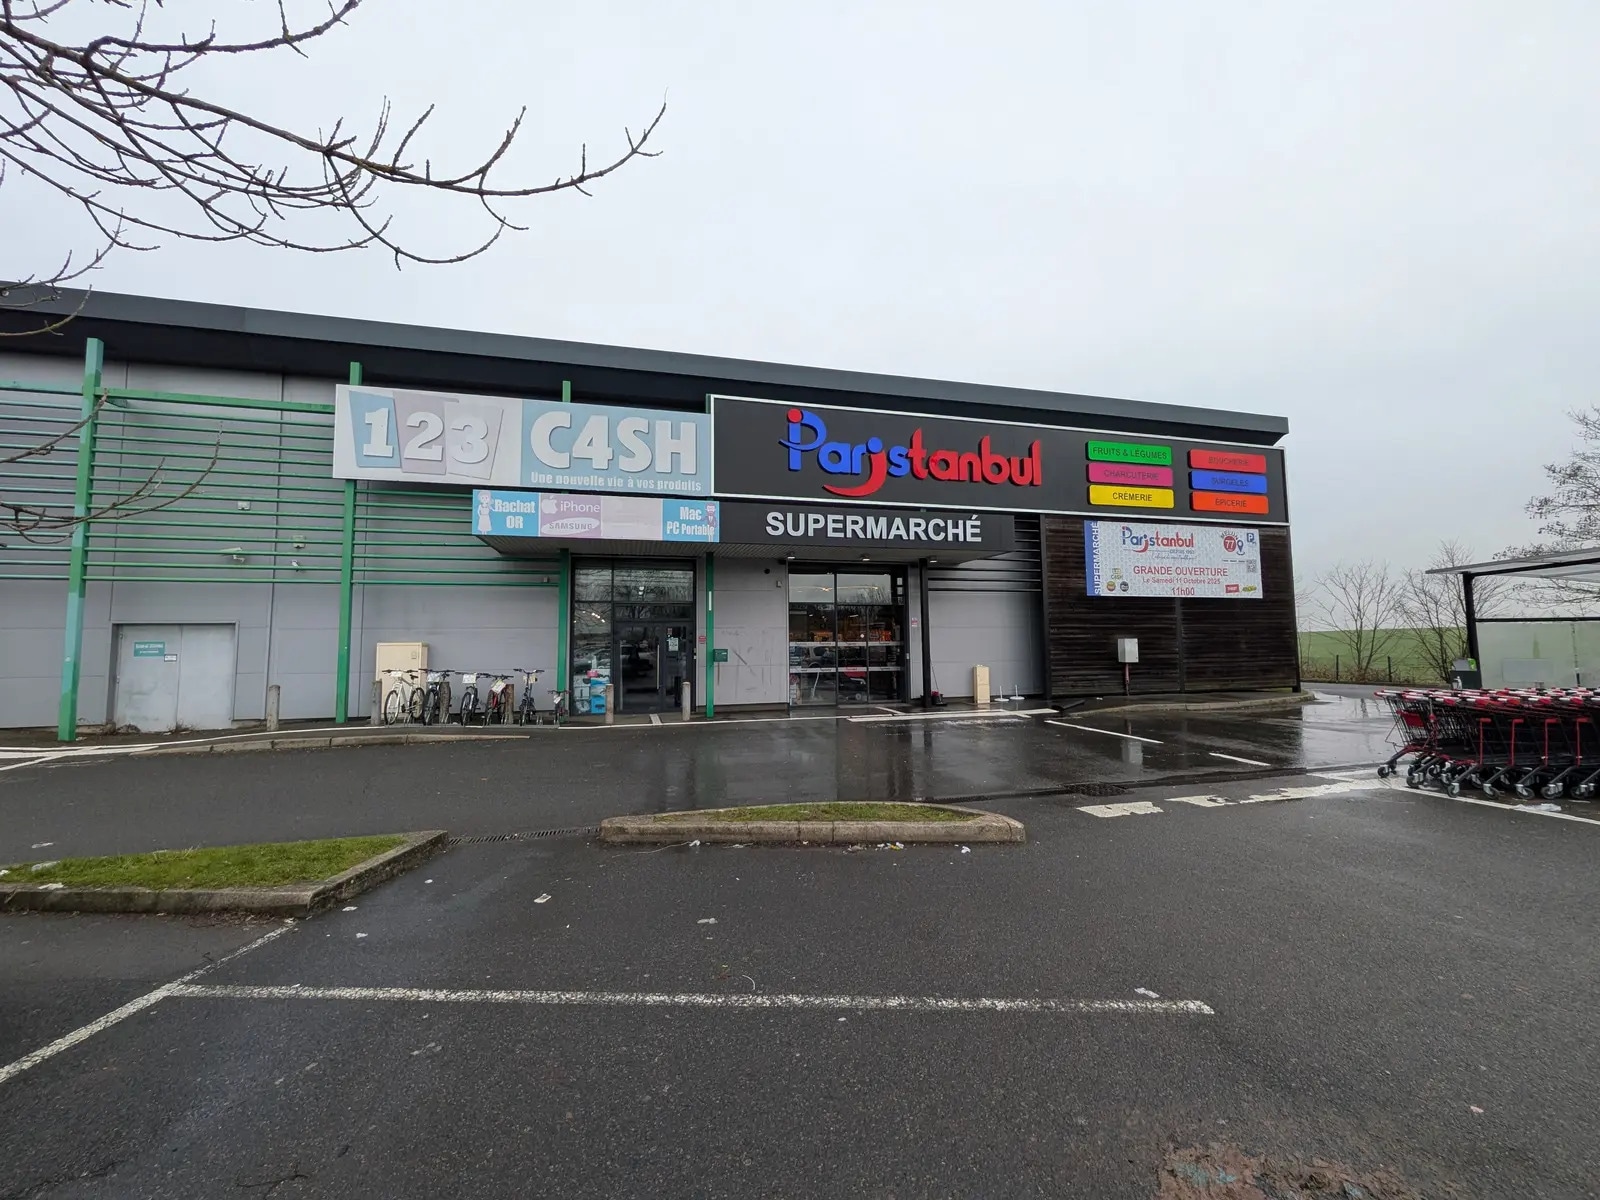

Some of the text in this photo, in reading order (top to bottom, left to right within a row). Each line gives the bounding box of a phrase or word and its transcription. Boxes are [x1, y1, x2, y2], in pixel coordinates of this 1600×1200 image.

[530, 411, 698, 475] C4SH
[1092, 446, 1168, 460] FRUITS & LÉGUMES
[531, 471, 702, 492] Une nouvelle vie à vos produits
[1103, 469, 1159, 481] CHARCUTERIE
[494, 498, 536, 514] Rachat
[560, 500, 600, 513] iPhone
[679, 506, 702, 521] Mac
[506, 515, 524, 530] OR
[549, 521, 594, 531] SAMSUNG
[666, 520, 715, 537] PC Portable
[765, 511, 982, 542] SUPERMARCHÉ
[1090, 520, 1101, 595] SUPERMARCHÉ
[1133, 565, 1173, 576] GRANDE
[1175, 567, 1229, 577] OUVERTURE
[1152, 577, 1175, 585] Samedi
[1175, 577, 1183, 585] 11
[1184, 578, 1207, 586] Octobre
[1171, 586, 1195, 596] 11h00
